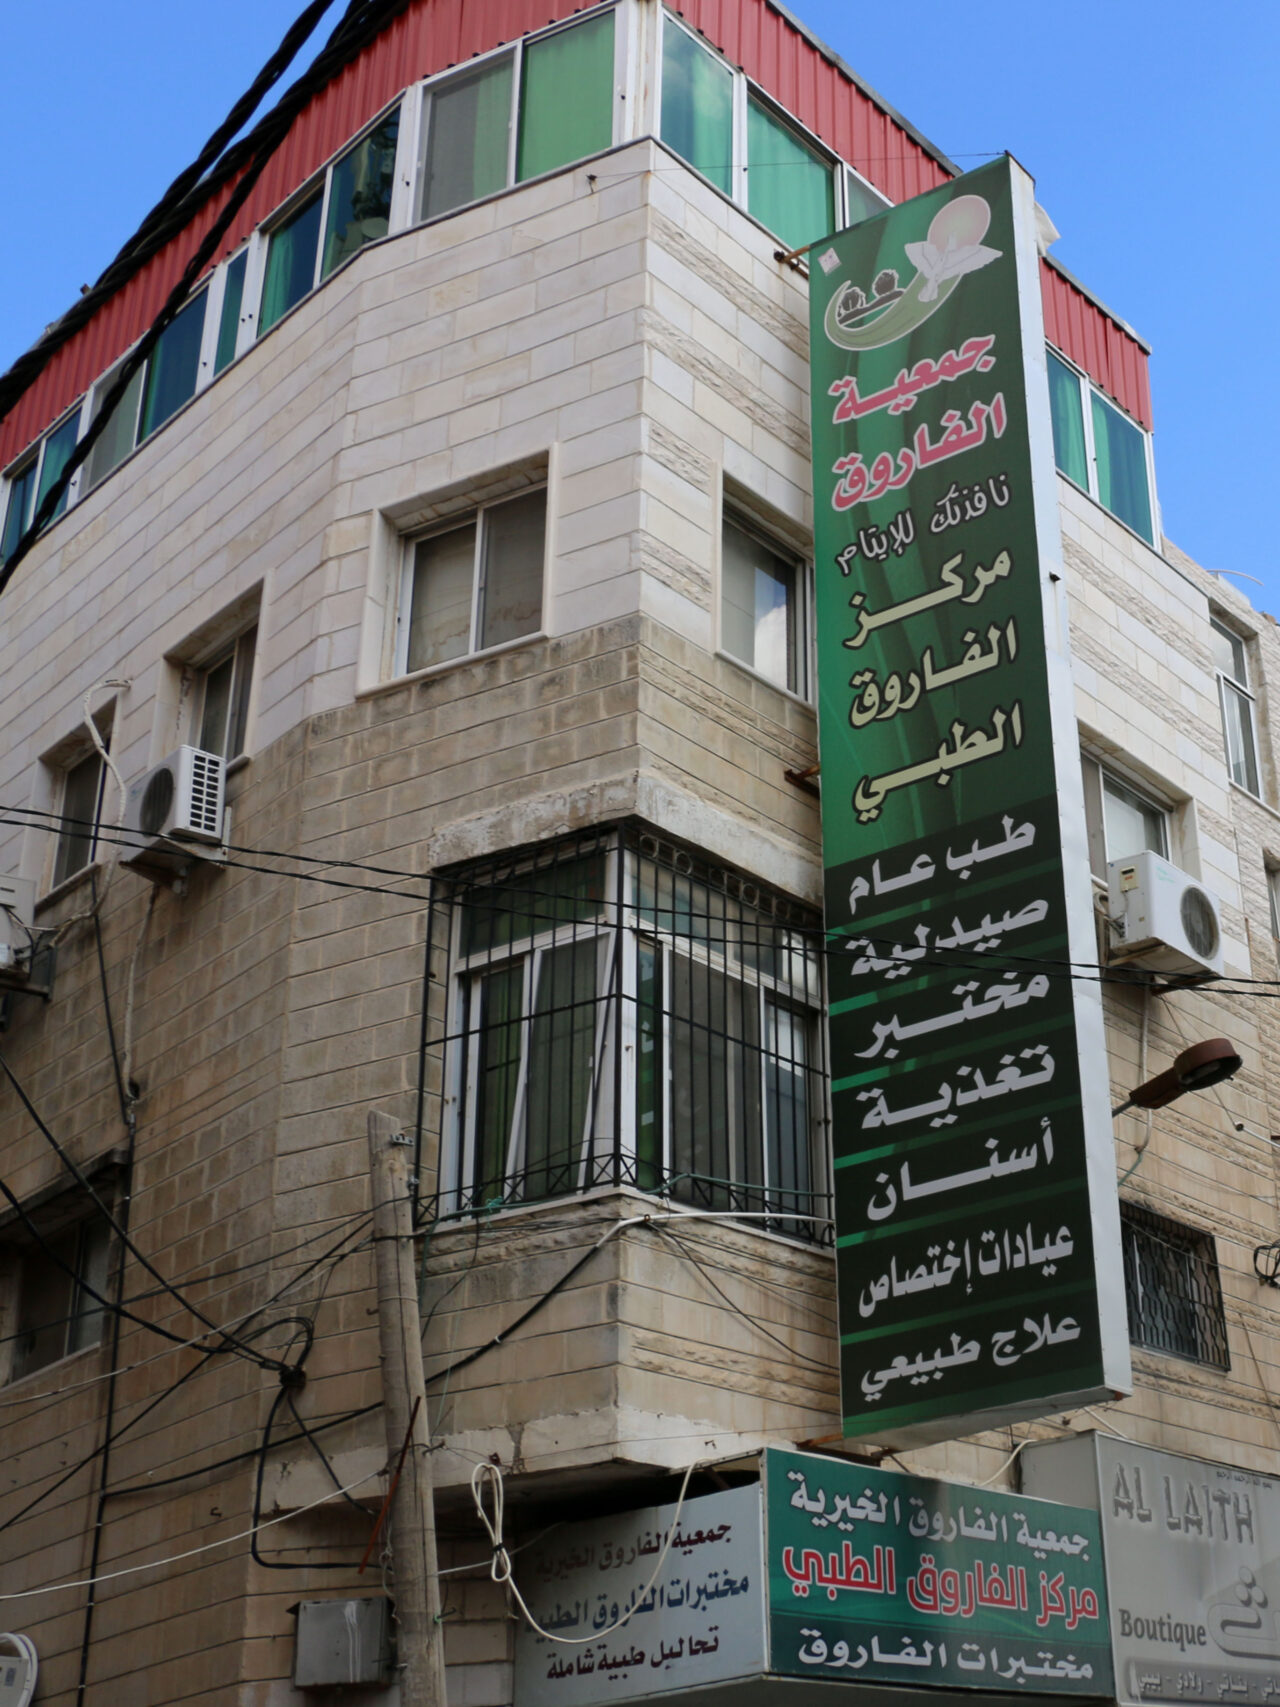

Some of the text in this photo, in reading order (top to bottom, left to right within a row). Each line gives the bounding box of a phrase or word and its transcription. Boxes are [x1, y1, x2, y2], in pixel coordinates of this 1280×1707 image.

[827, 334, 996, 424] جمعية
[831, 393, 1007, 511] الفاروق
[844, 550, 1011, 647] مركز
[850, 617, 1017, 726] الفاروق
[854, 703, 1022, 823] الطبي
[849, 814, 1036, 915] طب عام
[845, 899, 1049, 979] صيدلية
[854, 972, 1050, 1058] مختبر
[856, 1044, 1056, 1129] تغذية
[866, 1116, 1054, 1221] أسنان
[858, 1222, 1074, 1318] عيادات إختصاص
[860, 1313, 1081, 1402] علاج طبيعي
[672, 1521, 732, 1556] جمعية
[787, 1470, 1089, 1562] جمعية الفاروق الخيرية
[1113, 1462, 1254, 1544] AL LAITH
[599, 1531, 669, 1572] الفاروق
[667, 1569, 749, 1612] مختبرات
[782, 1541, 1099, 1630] مركز الفاروق الطبي
[592, 1580, 664, 1631] الفاروق
[1119, 1608, 1207, 1651] Boutique
[546, 1625, 719, 1681] تحاليل طبية شاملة
[798, 1628, 1094, 1684] مختبرات الفاروق
